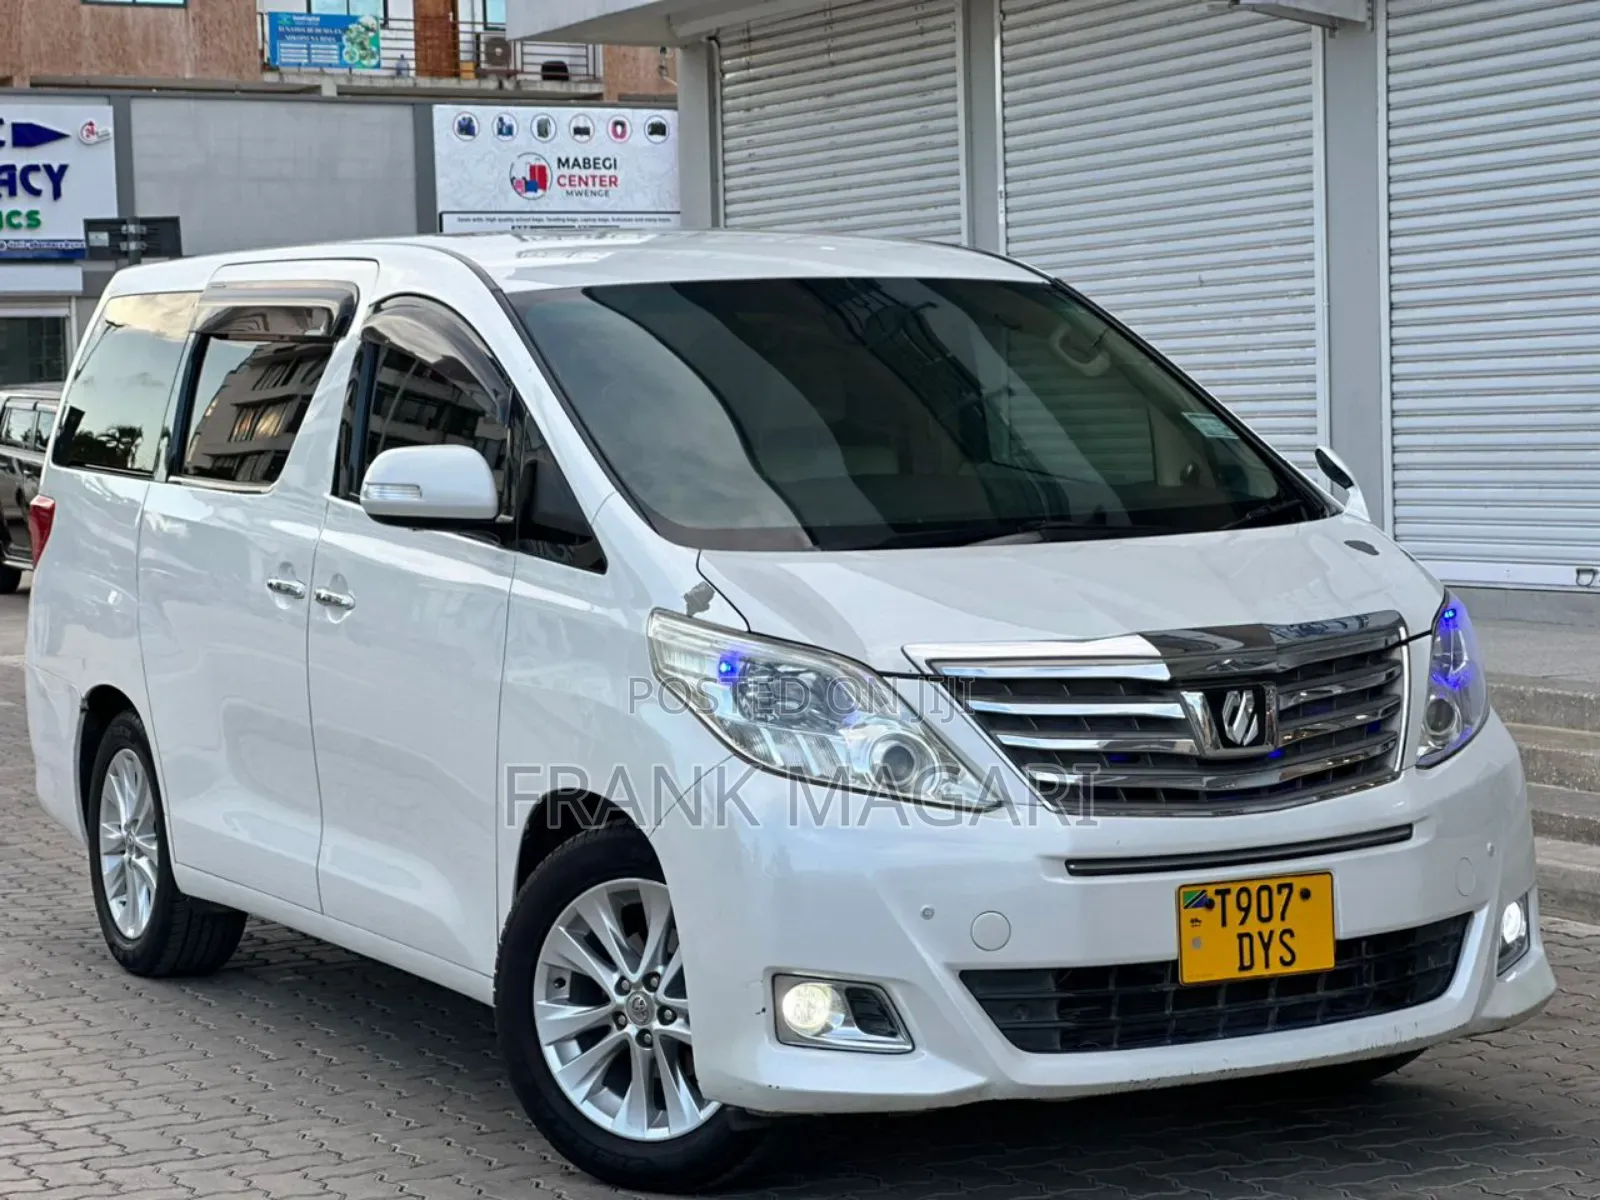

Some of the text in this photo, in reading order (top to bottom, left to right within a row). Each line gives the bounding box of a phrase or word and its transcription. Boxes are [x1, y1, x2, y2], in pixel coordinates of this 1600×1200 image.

[557, 157, 617, 170] MABEGI
[557, 174, 619, 187] CENTER
[1214, 882, 1294, 928] T907
[1236, 928, 1297, 972] DYS
